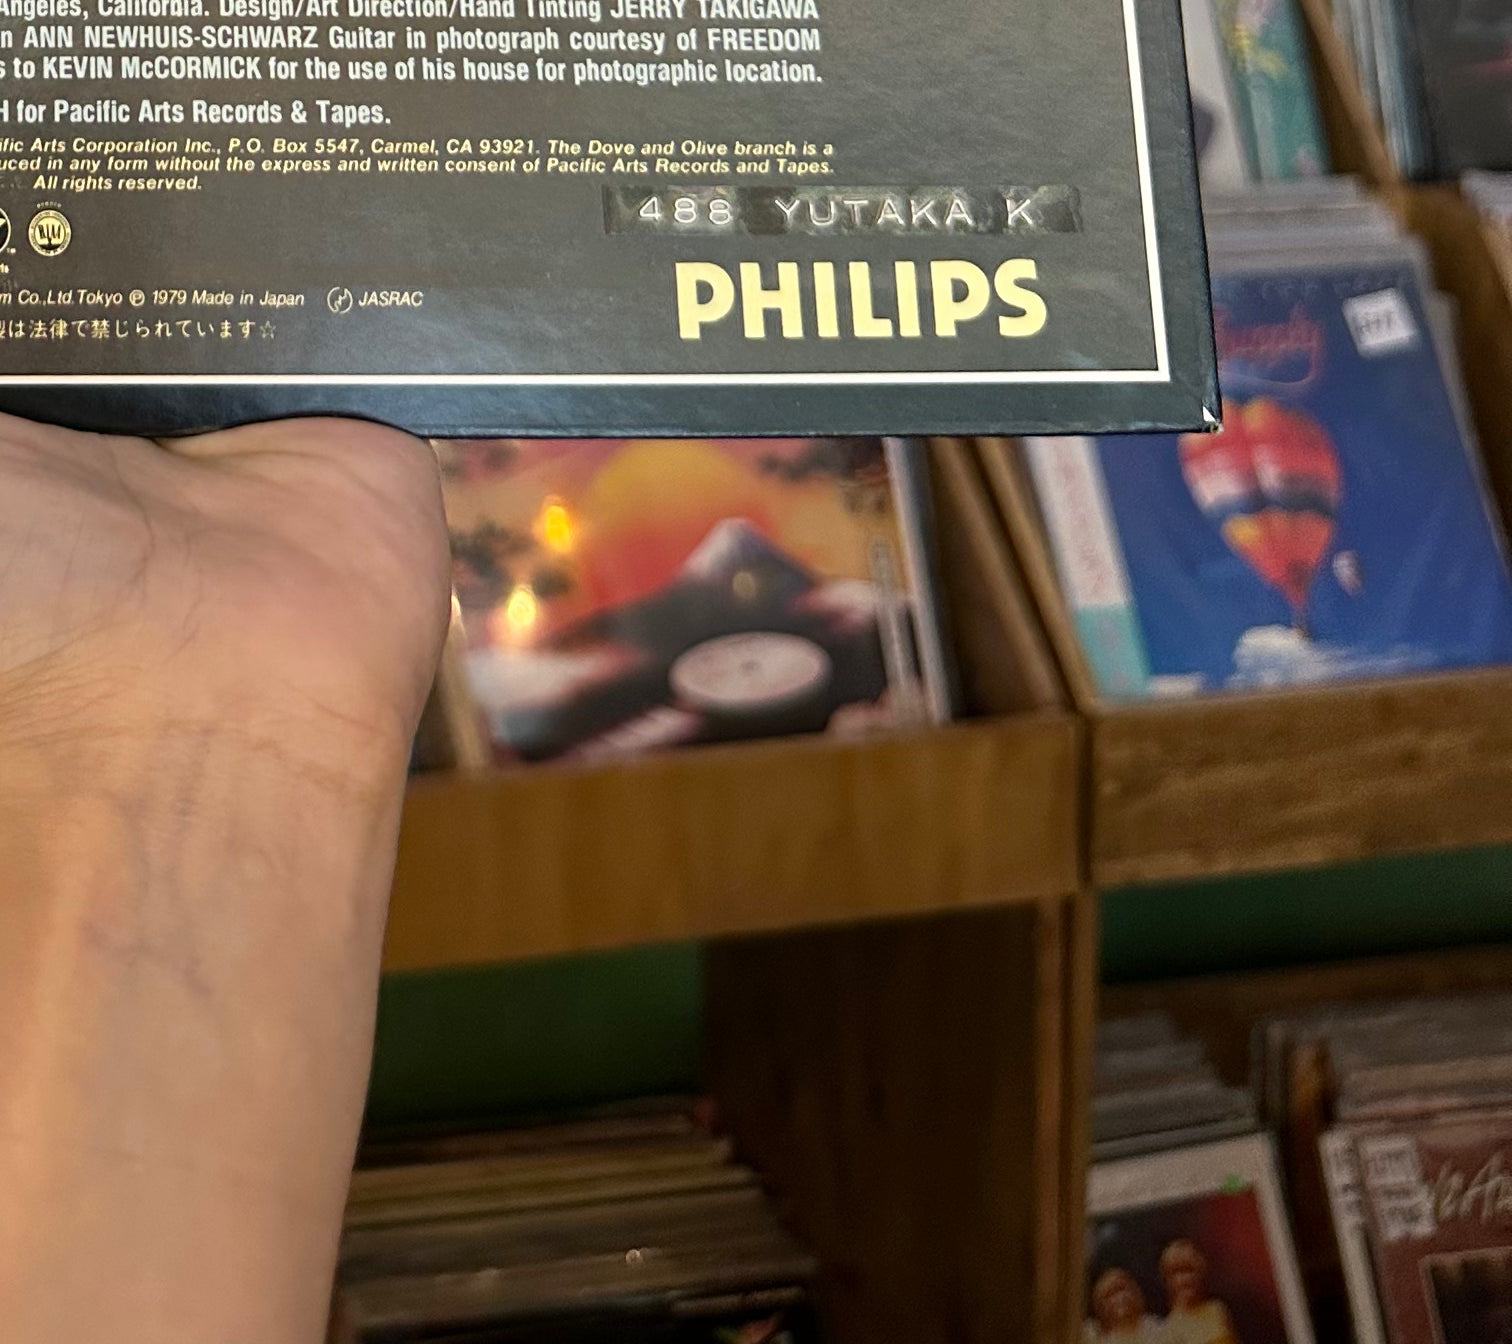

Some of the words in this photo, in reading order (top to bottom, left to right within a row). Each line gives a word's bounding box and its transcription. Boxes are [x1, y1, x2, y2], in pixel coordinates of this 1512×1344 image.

[16, 100, 47, 123] for
[53, 100, 131, 123] Pacific
[138, 100, 185, 123] Arts
[192, 100, 283, 123] Records
[290, 100, 308, 123] &
[315, 100, 391, 127] Tapes.
[29, 138, 66, 153] Arts
[71, 138, 180, 156] Corporation
[184, 138, 222, 155] Inc.,
[227, 138, 265, 153] P.O.
[272, 138, 307, 153] Box
[313, 138, 365, 155] 5547,
[368, 138, 440, 156] Carmel,
[445, 139, 473, 154] CA
[478, 139, 542, 154] 93921.
[546, 139, 582, 154] The
[587, 139, 635, 155] Dove
[640, 140, 675, 155] and
[680, 140, 728, 155] Olive
[734, 140, 797, 156] branch
[802, 141, 818, 156] is
[823, 144, 834, 156] a
[33, 175, 57, 190] All
[62, 175, 113, 193] rights
[118, 175, 203, 190] reserved.
[637, 194, 736, 227] 488
[774, 194, 975, 227] YUTAKA
[1005, 195, 1036, 227] K
[151, 289, 187, 305] 1979
[191, 289, 235, 305] Made
[239, 289, 254, 305] in
[259, 289, 306, 308] Japan
[357, 290, 425, 309] JASRAC
[674, 257, 1048, 340] PHILIPS
